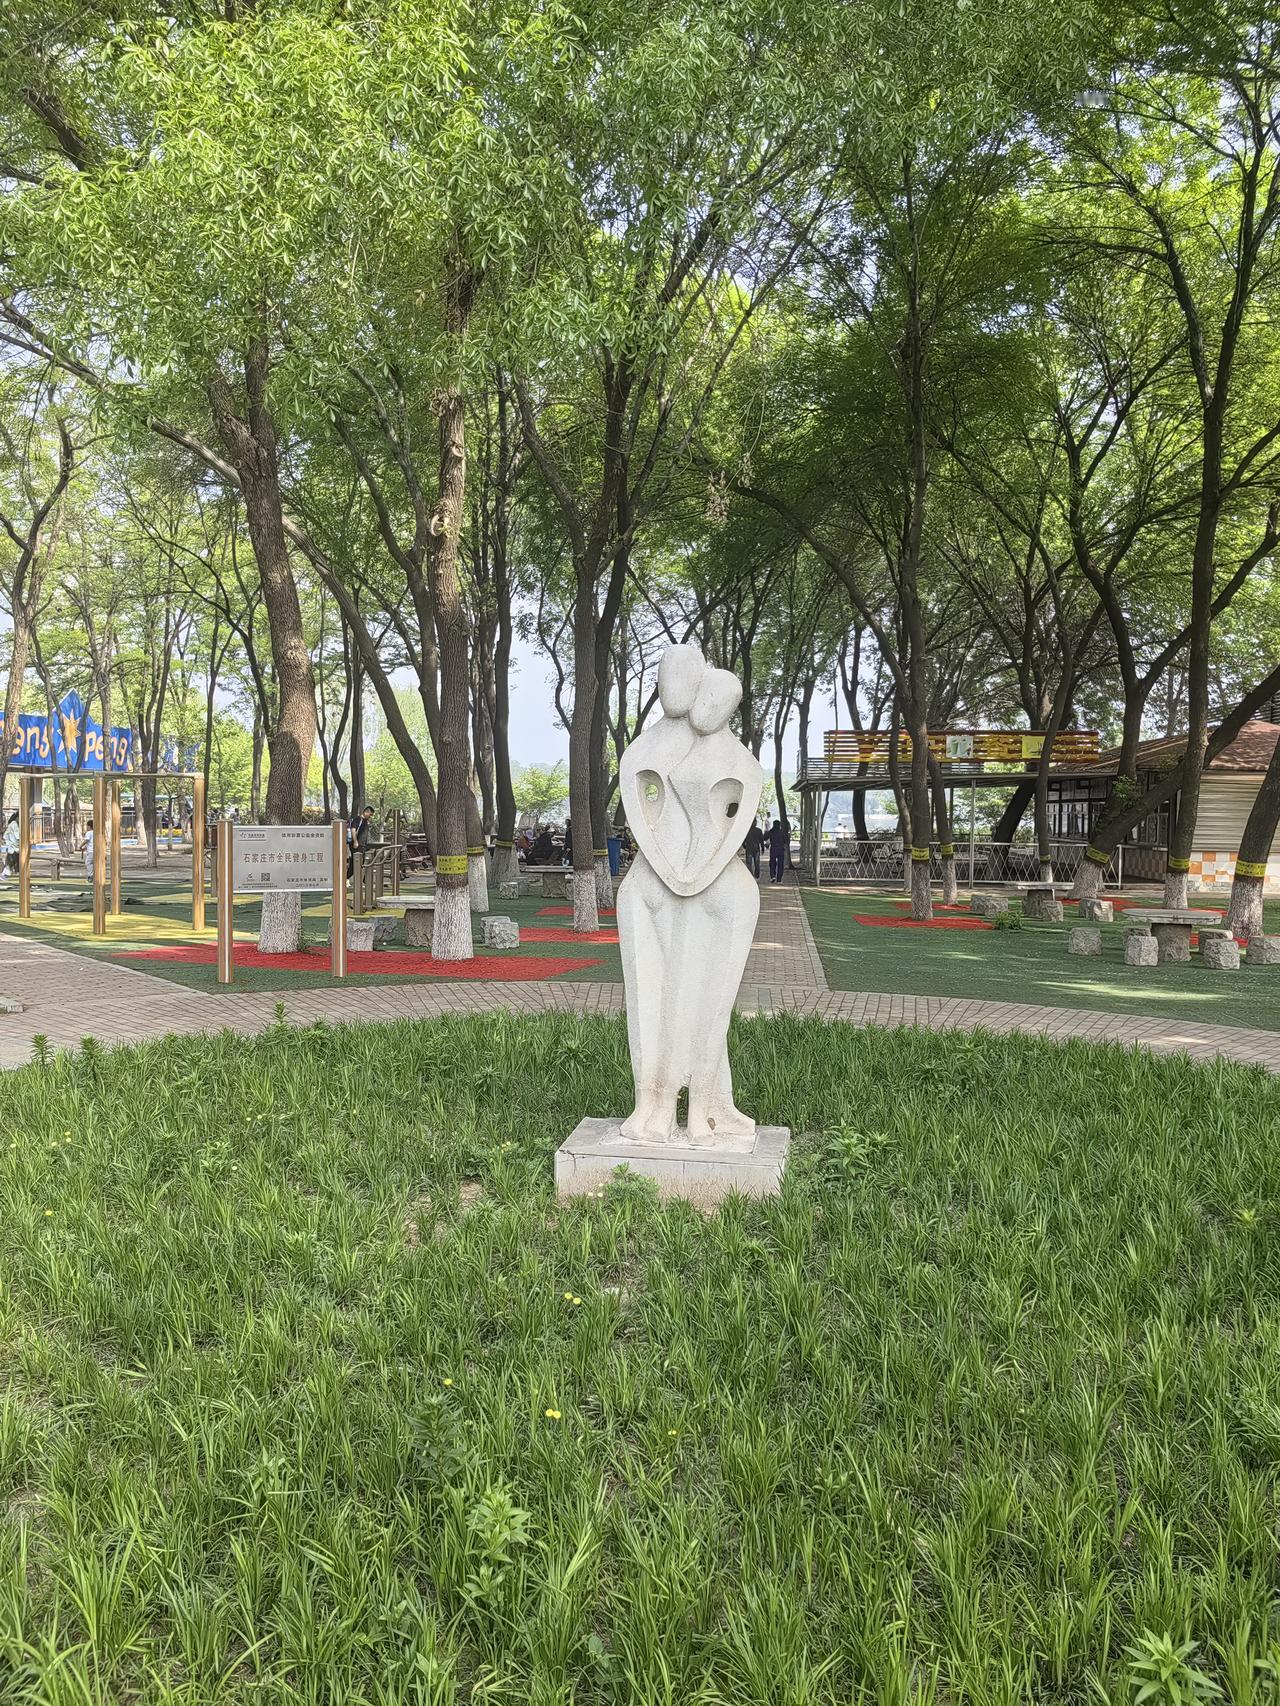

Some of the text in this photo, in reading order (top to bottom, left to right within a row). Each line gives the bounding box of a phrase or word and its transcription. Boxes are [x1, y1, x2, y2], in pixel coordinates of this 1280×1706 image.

[243, 852, 324, 864] 石家庄市全民健身工程
